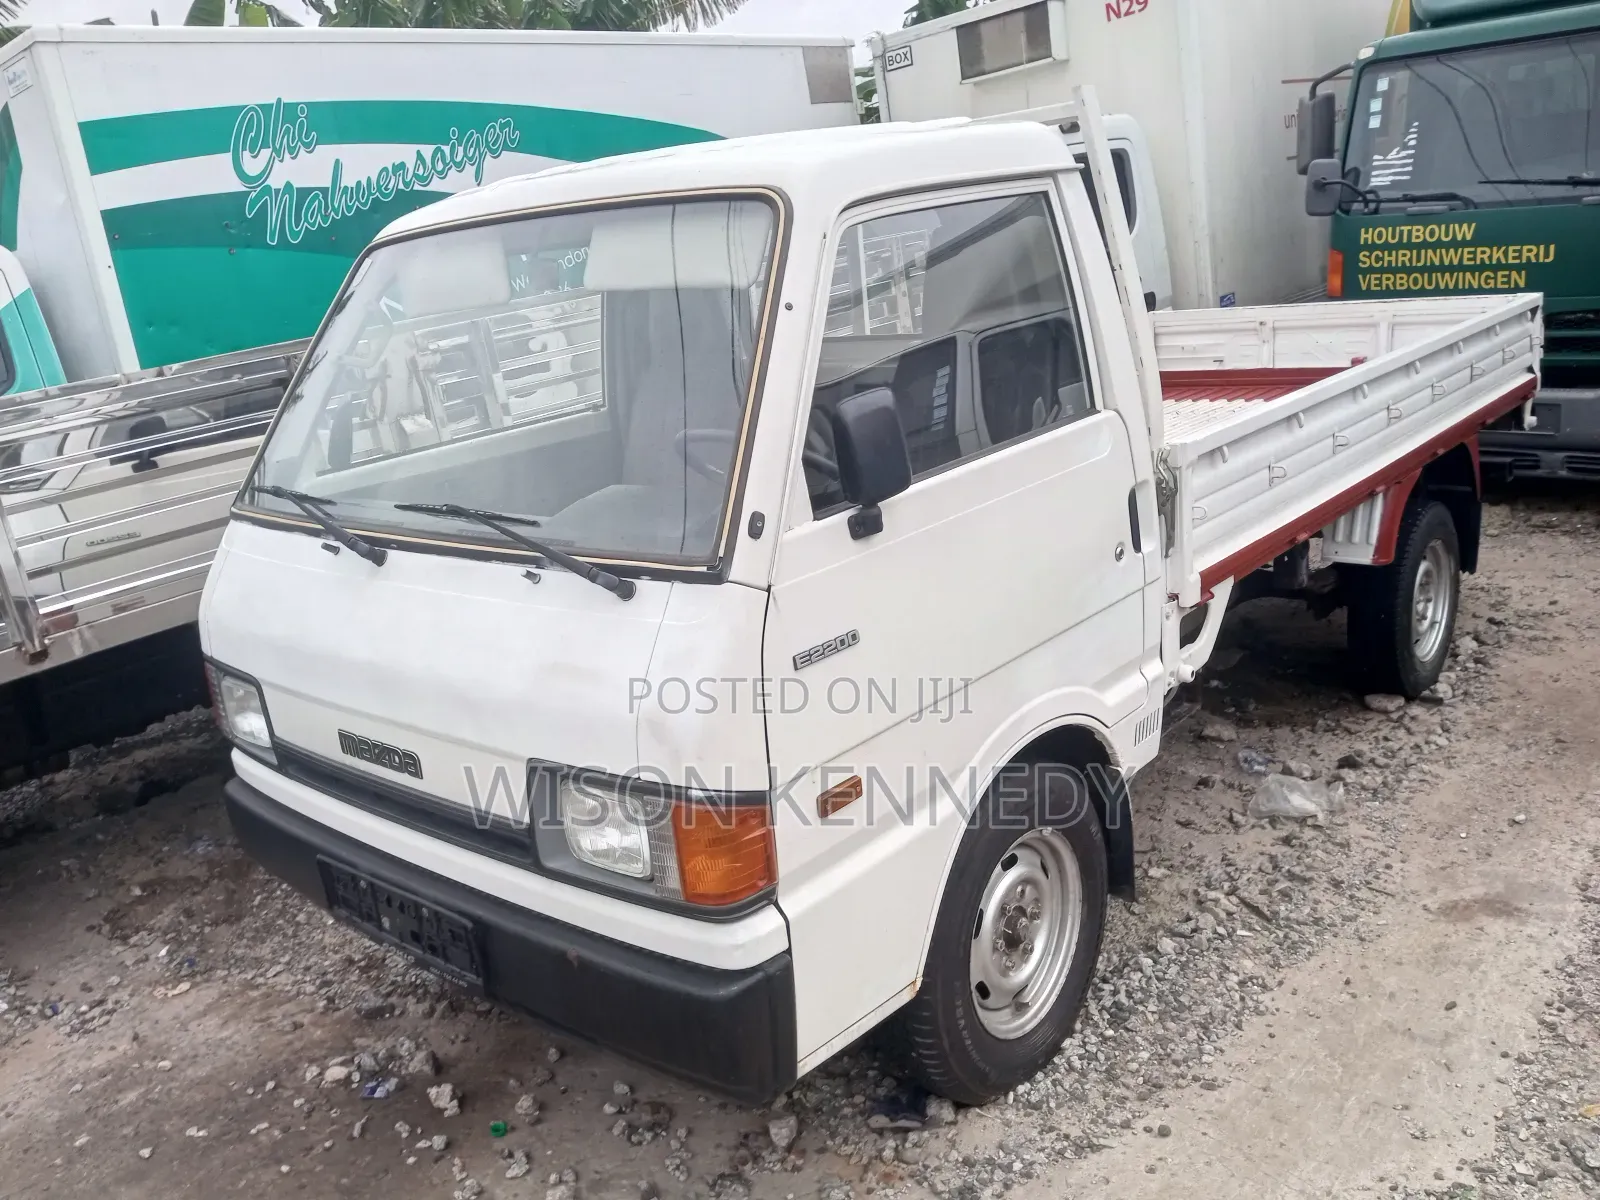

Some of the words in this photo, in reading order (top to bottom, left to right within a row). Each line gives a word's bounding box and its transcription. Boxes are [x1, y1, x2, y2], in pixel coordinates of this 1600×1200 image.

[887, 51, 910, 66] BOX
[230, 97, 317, 189] Chi
[246, 117, 519, 245] Nahversoiger
[1359, 222, 1477, 245] HOUTBOUW
[1358, 244, 1556, 268] SCHRIJNWERKERIJ
[1358, 270, 1527, 291] VERBOUWINGEN
[792, 629, 861, 671] E2200
